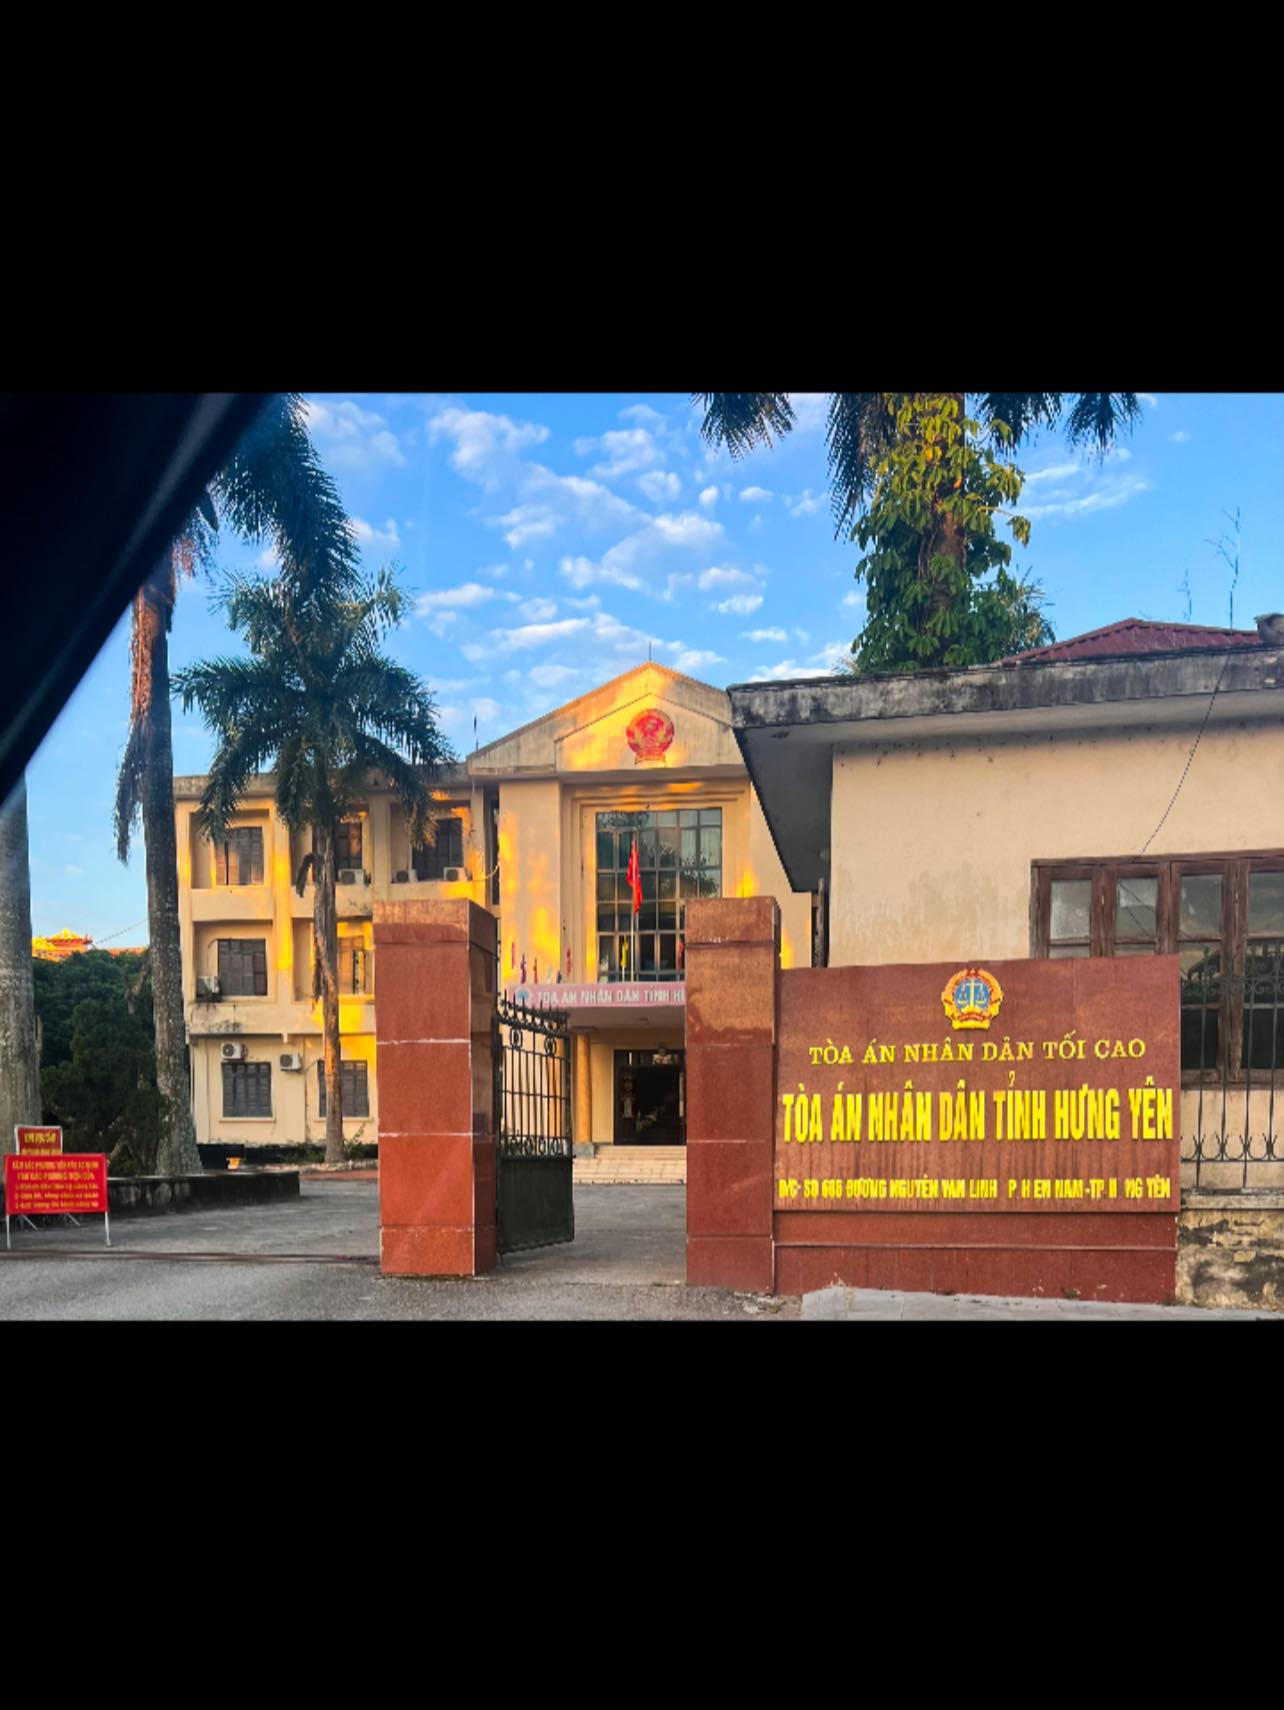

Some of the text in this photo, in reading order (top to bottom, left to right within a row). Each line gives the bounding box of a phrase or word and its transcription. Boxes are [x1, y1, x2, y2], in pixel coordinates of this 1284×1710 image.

[809, 1029, 1146, 1064] TÒA ÁN NHÂN DÂN TỐI CAO
[782, 1070, 1173, 1143] TÒA ÁN NHÂN DÂN TỈNH HƯNG YÊN
[969, 1178, 998, 1199] LINH
